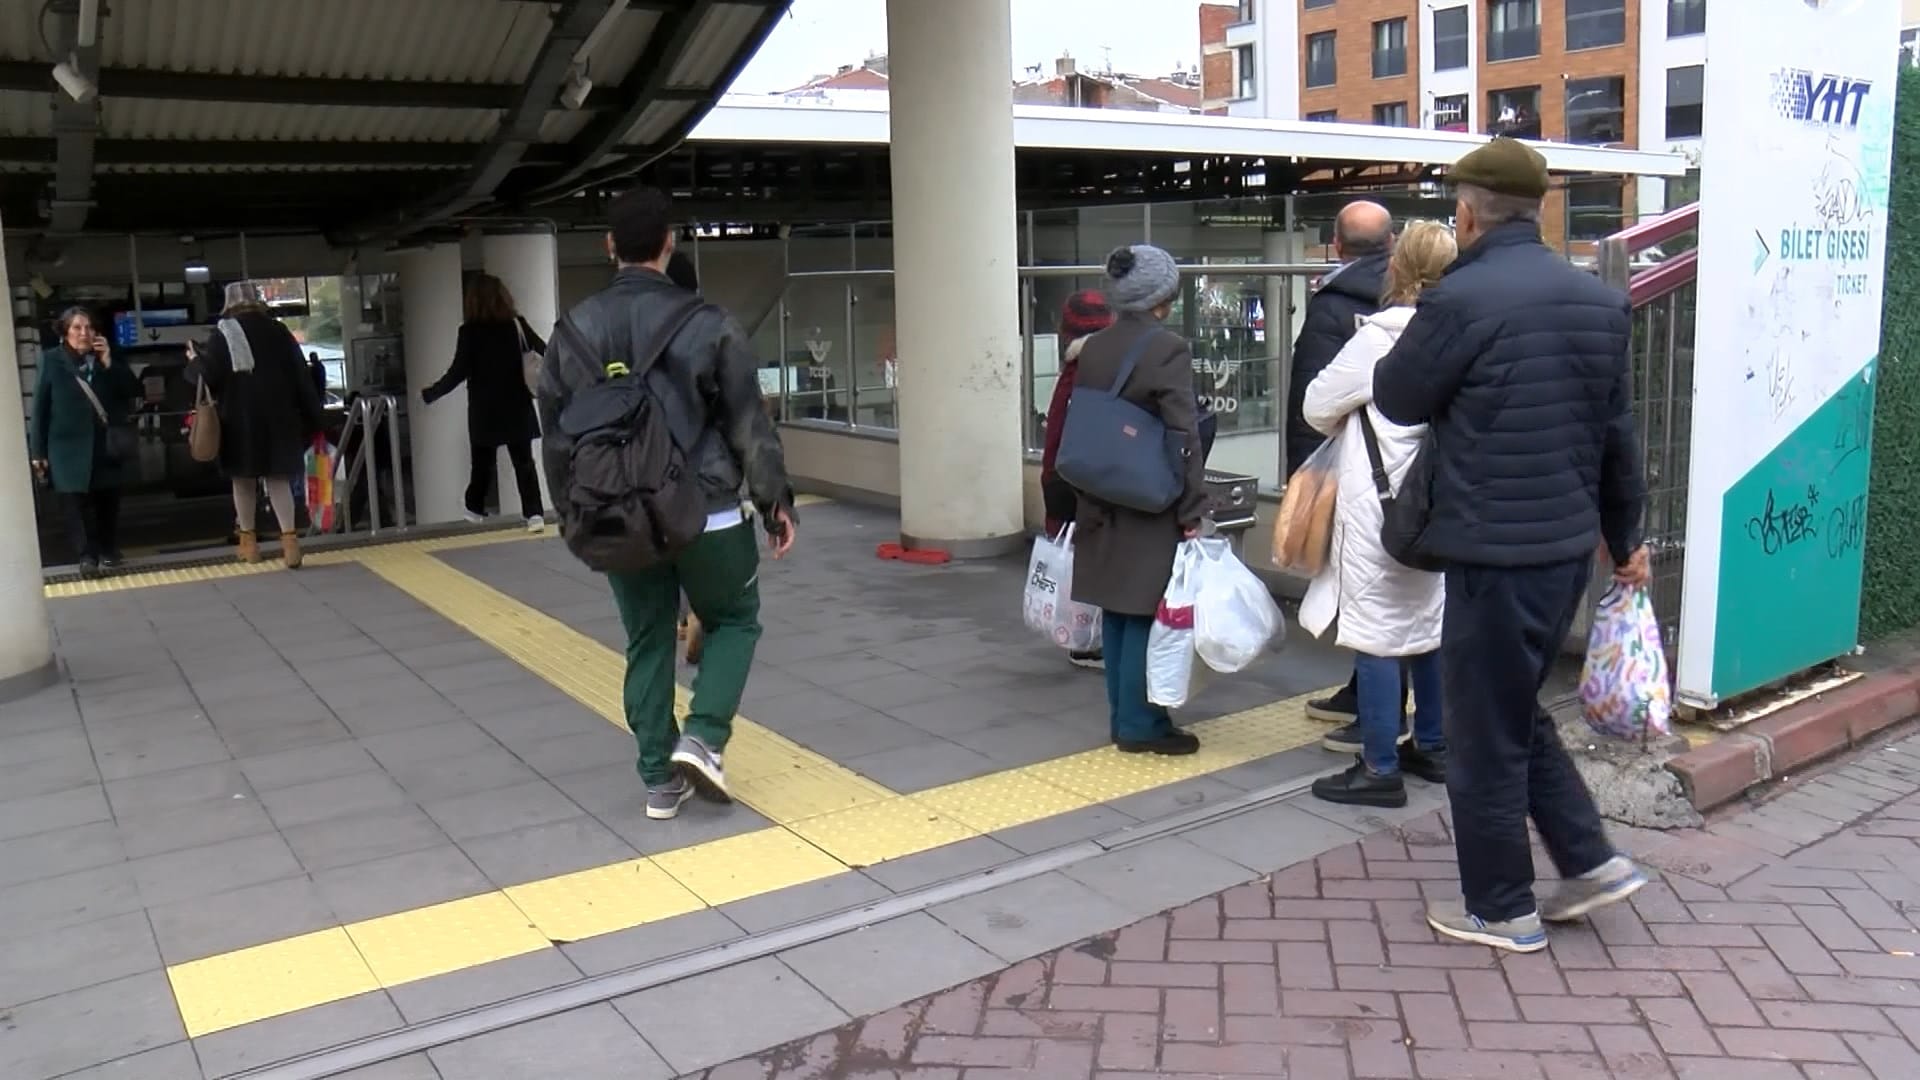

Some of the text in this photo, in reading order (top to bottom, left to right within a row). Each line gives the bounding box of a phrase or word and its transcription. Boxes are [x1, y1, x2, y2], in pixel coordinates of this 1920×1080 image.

[1804, 74, 1871, 126] YHT
[1781, 221, 1823, 260] BİLET
[1837, 274, 1868, 294] TICKET
